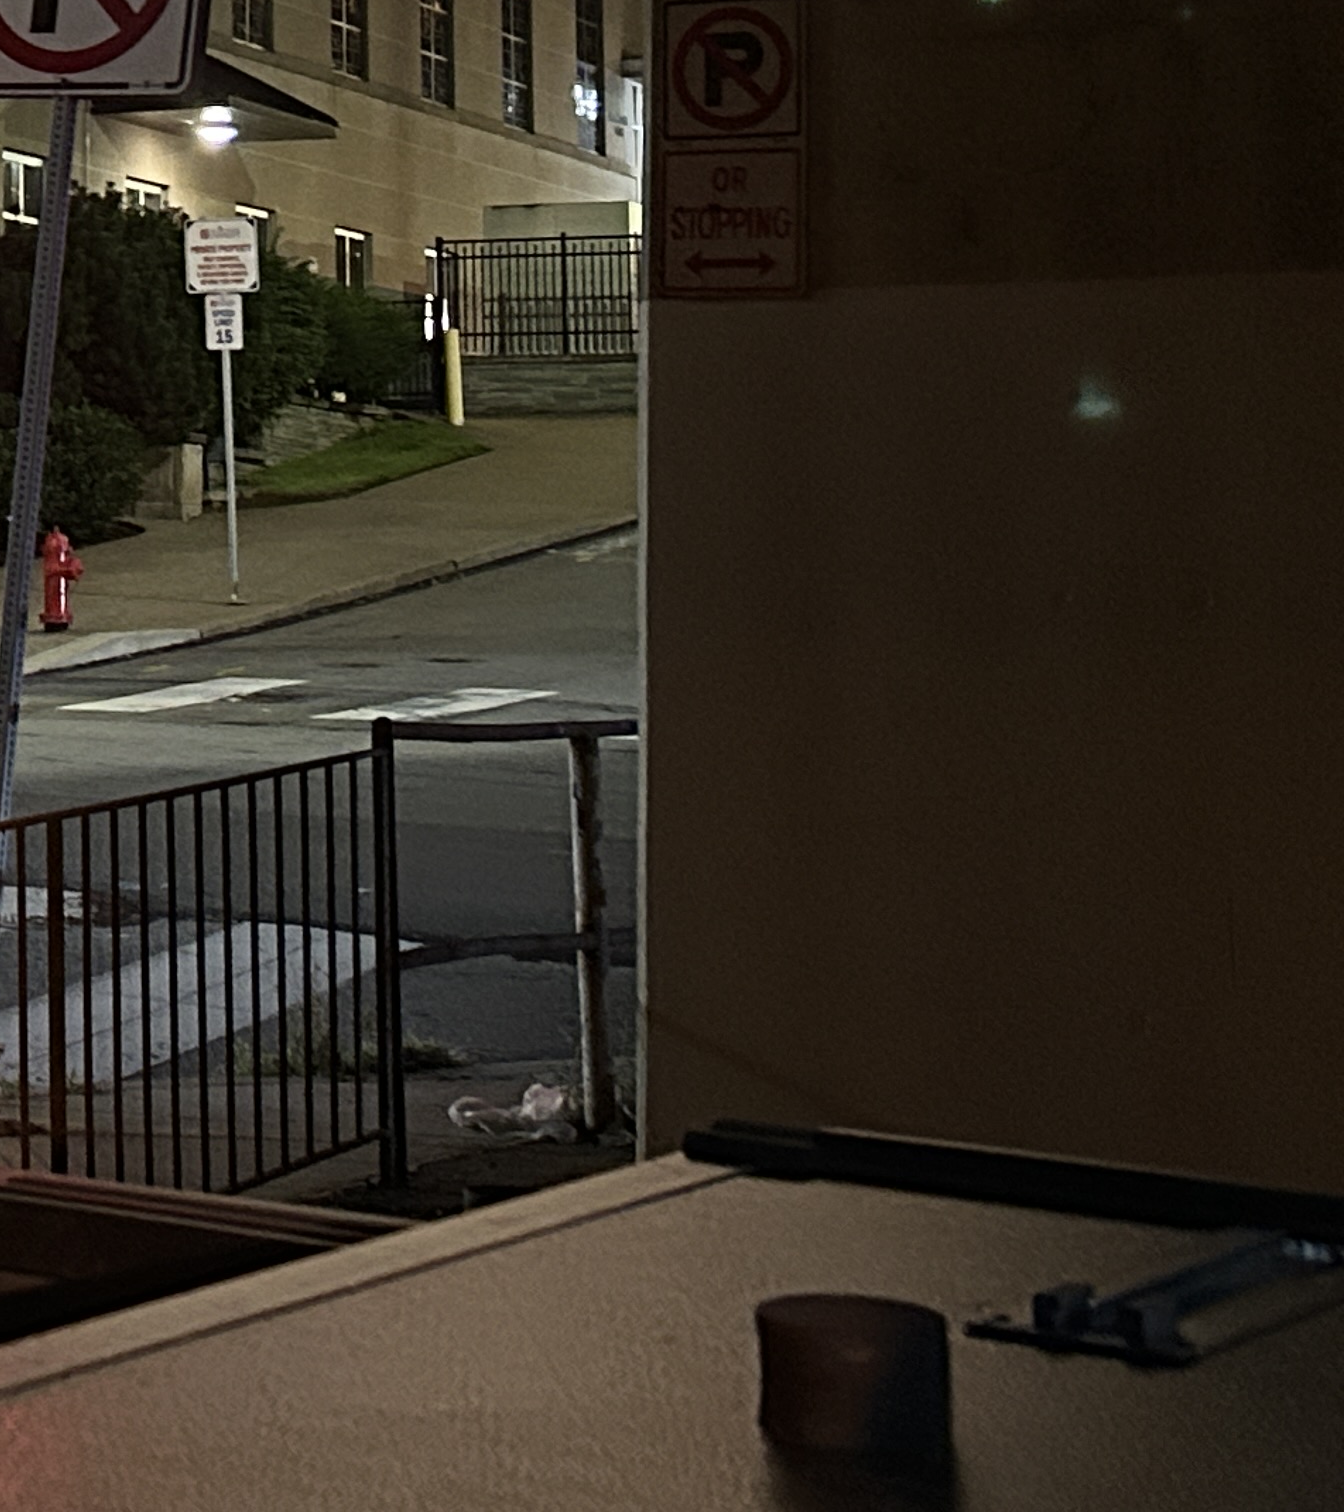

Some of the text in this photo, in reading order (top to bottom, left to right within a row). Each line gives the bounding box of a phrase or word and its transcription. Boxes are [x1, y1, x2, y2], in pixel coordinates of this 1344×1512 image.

[712, 166, 748, 192] OR
[670, 205, 793, 240] STOPPING
[216, 329, 234, 344] 15
